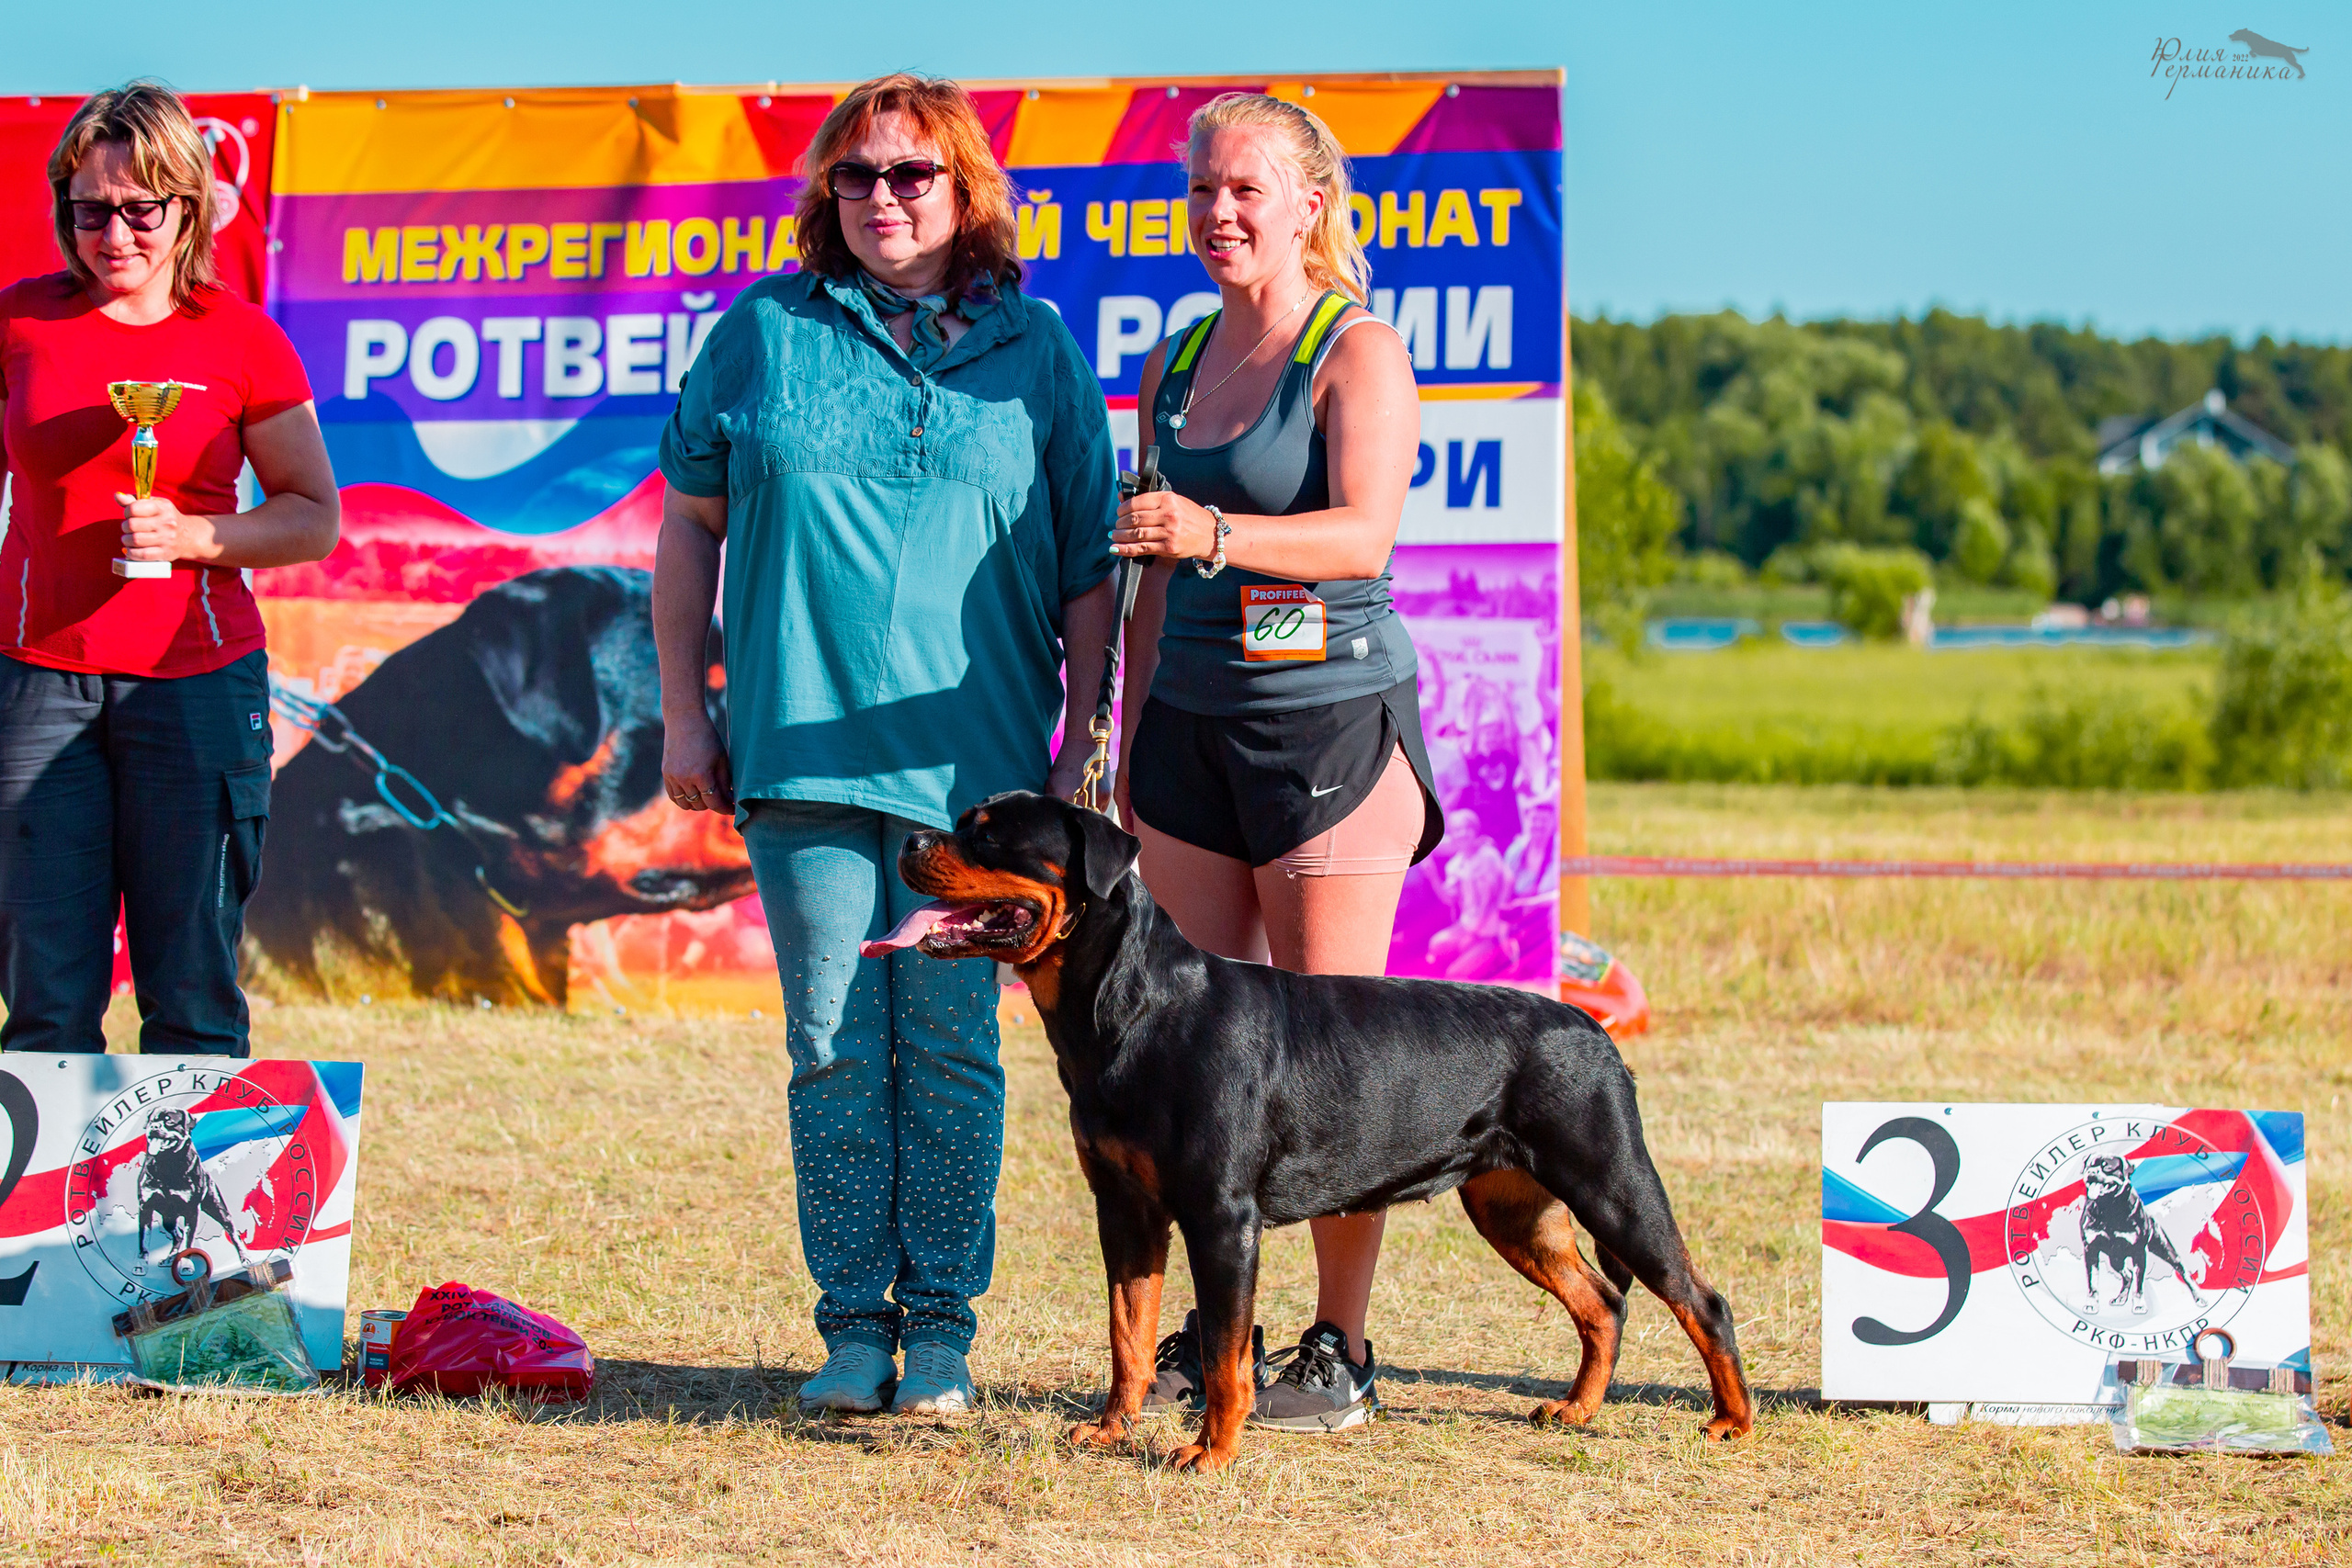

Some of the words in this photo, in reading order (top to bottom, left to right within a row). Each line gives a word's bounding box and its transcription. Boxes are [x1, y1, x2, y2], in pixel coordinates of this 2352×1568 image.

[345, 290, 726, 400] РОТВЕЙ
[1250, 589, 1306, 601] PROFIFEE
[1254, 607, 1305, 641] 60
[71, 1077, 173, 1249] РОТВЕЙЛЕР
[192, 1074, 274, 1114] КЛУБ
[277, 1122, 312, 1255] РОССИИ
[2011, 1125, 2106, 1288] РОТВЕЙЛЕР
[2127, 1122, 2211, 1161] КЛУБ
[2219, 1168, 2262, 1294] РОССИИ
[1852, 1117, 1972, 1346] 3
[429, 1291, 468, 1302] XXIV
[481, 1312, 529, 1337] ТВЕРИ
[2071, 1317, 2210, 1351] РКФ-НКПР
[22, 1362, 60, 1374] Корма
[1980, 1404, 2020, 1415] Корма
[2022, 1405, 2063, 1415] нового
